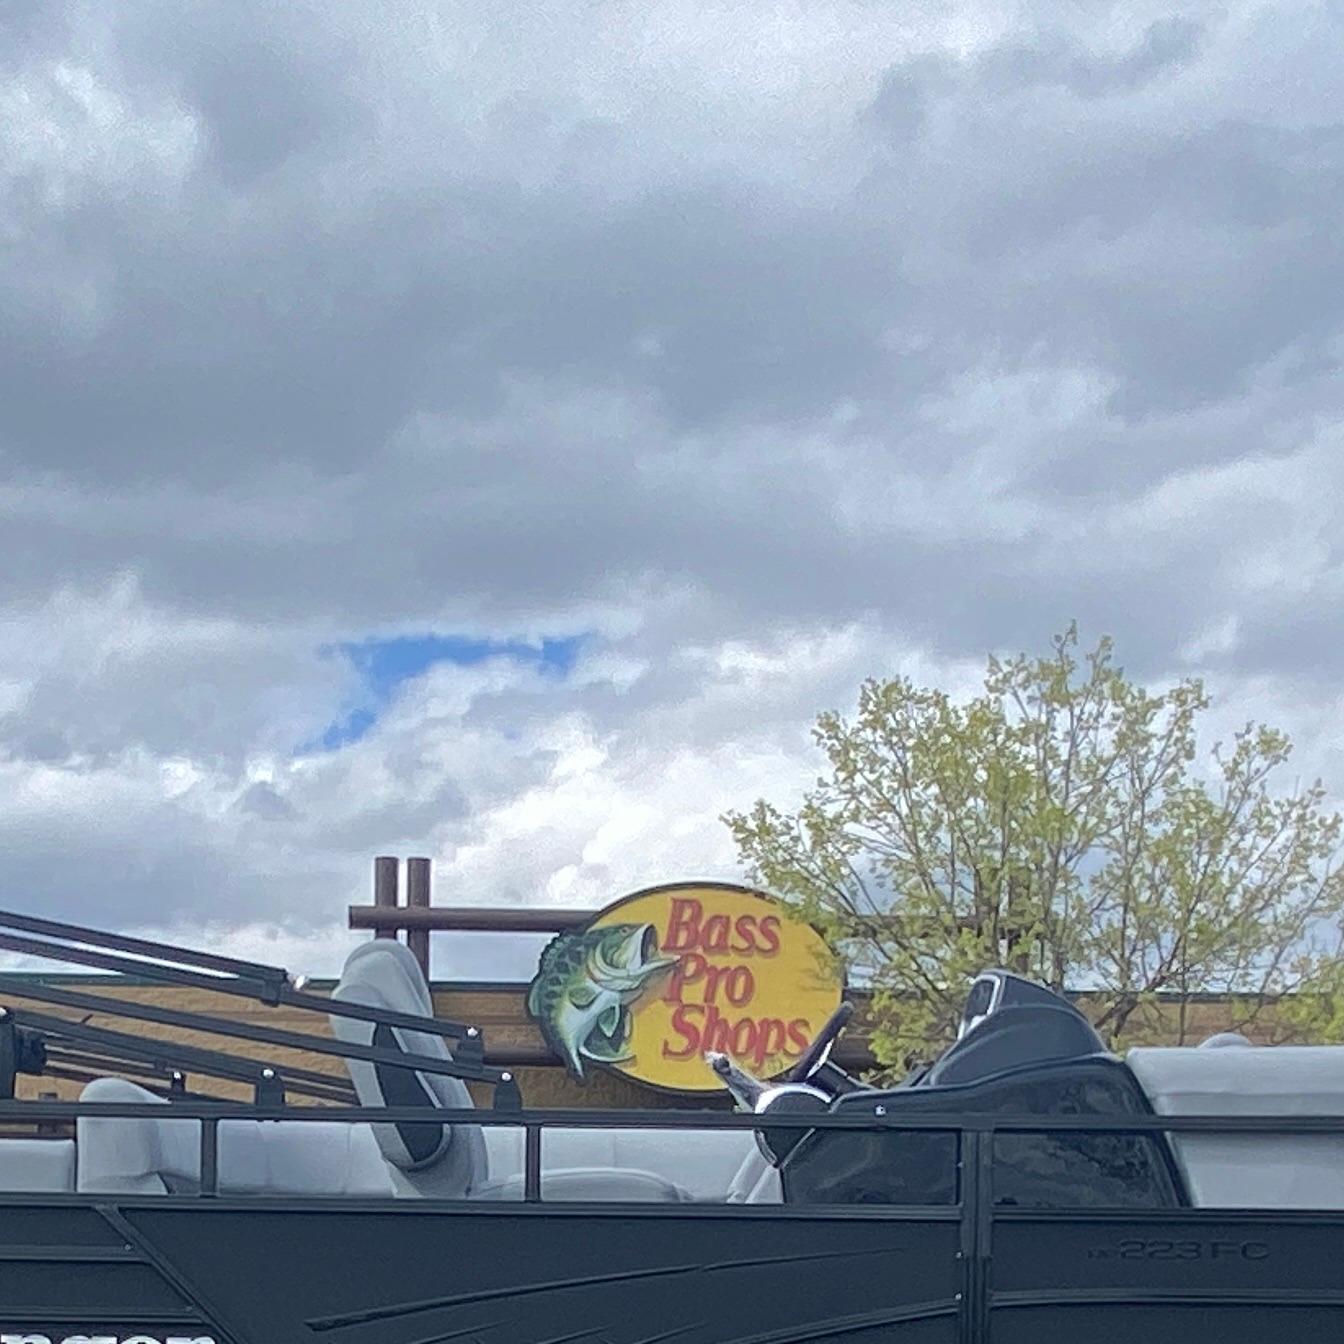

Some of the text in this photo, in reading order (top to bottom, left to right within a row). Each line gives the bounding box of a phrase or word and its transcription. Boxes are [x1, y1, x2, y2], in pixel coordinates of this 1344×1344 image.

[661, 897, 782, 958] Bass
[665, 953, 755, 1008] Pro
[662, 1003, 812, 1074] Shops
